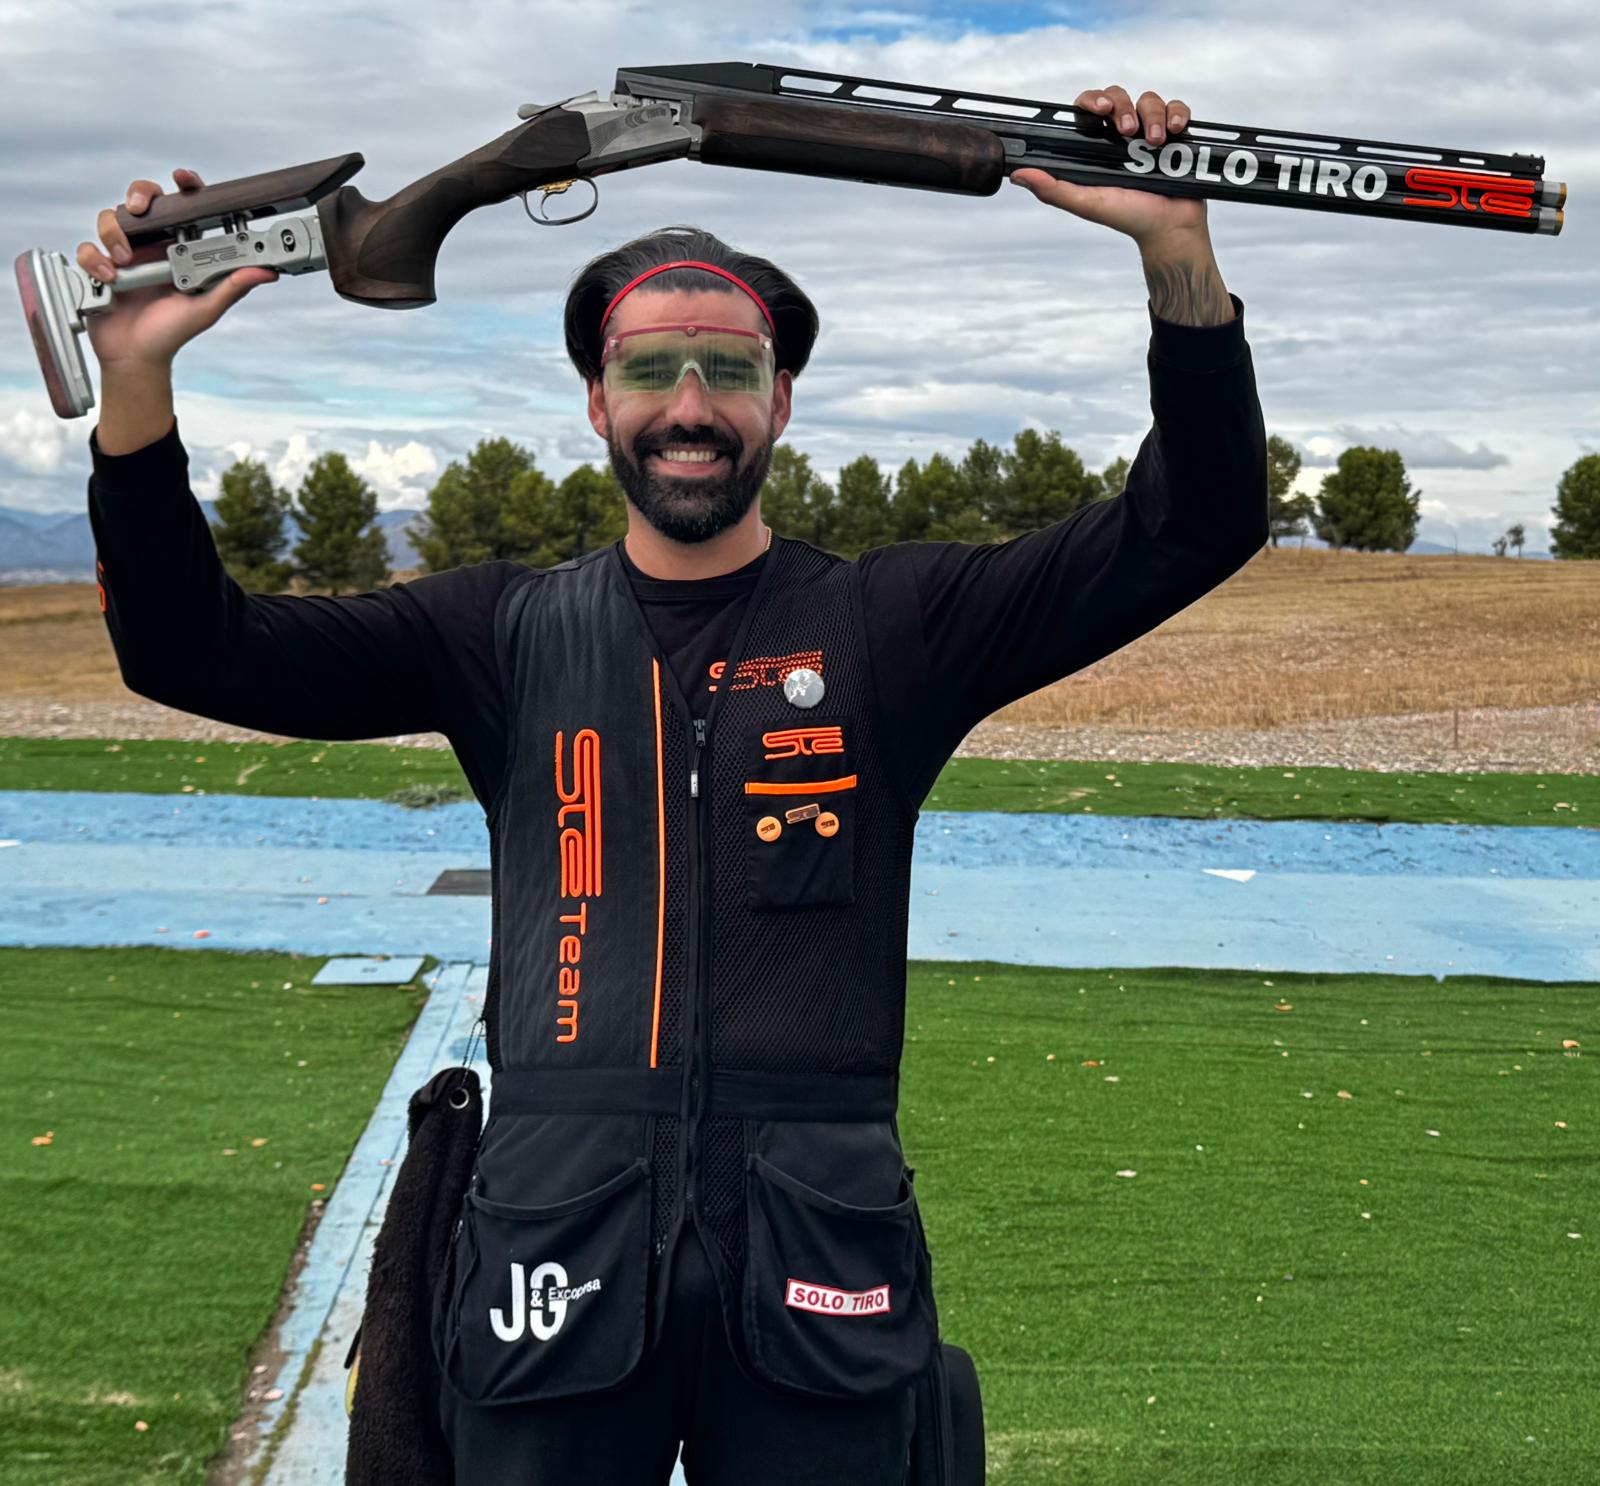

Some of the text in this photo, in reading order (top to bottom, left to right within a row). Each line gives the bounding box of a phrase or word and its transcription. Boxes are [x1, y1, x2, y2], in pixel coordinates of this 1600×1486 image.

[1123, 138, 1388, 201] SOLO TIRO
[556, 902, 588, 1043] Team
[793, 1287, 884, 1312] SOLO TIRO
